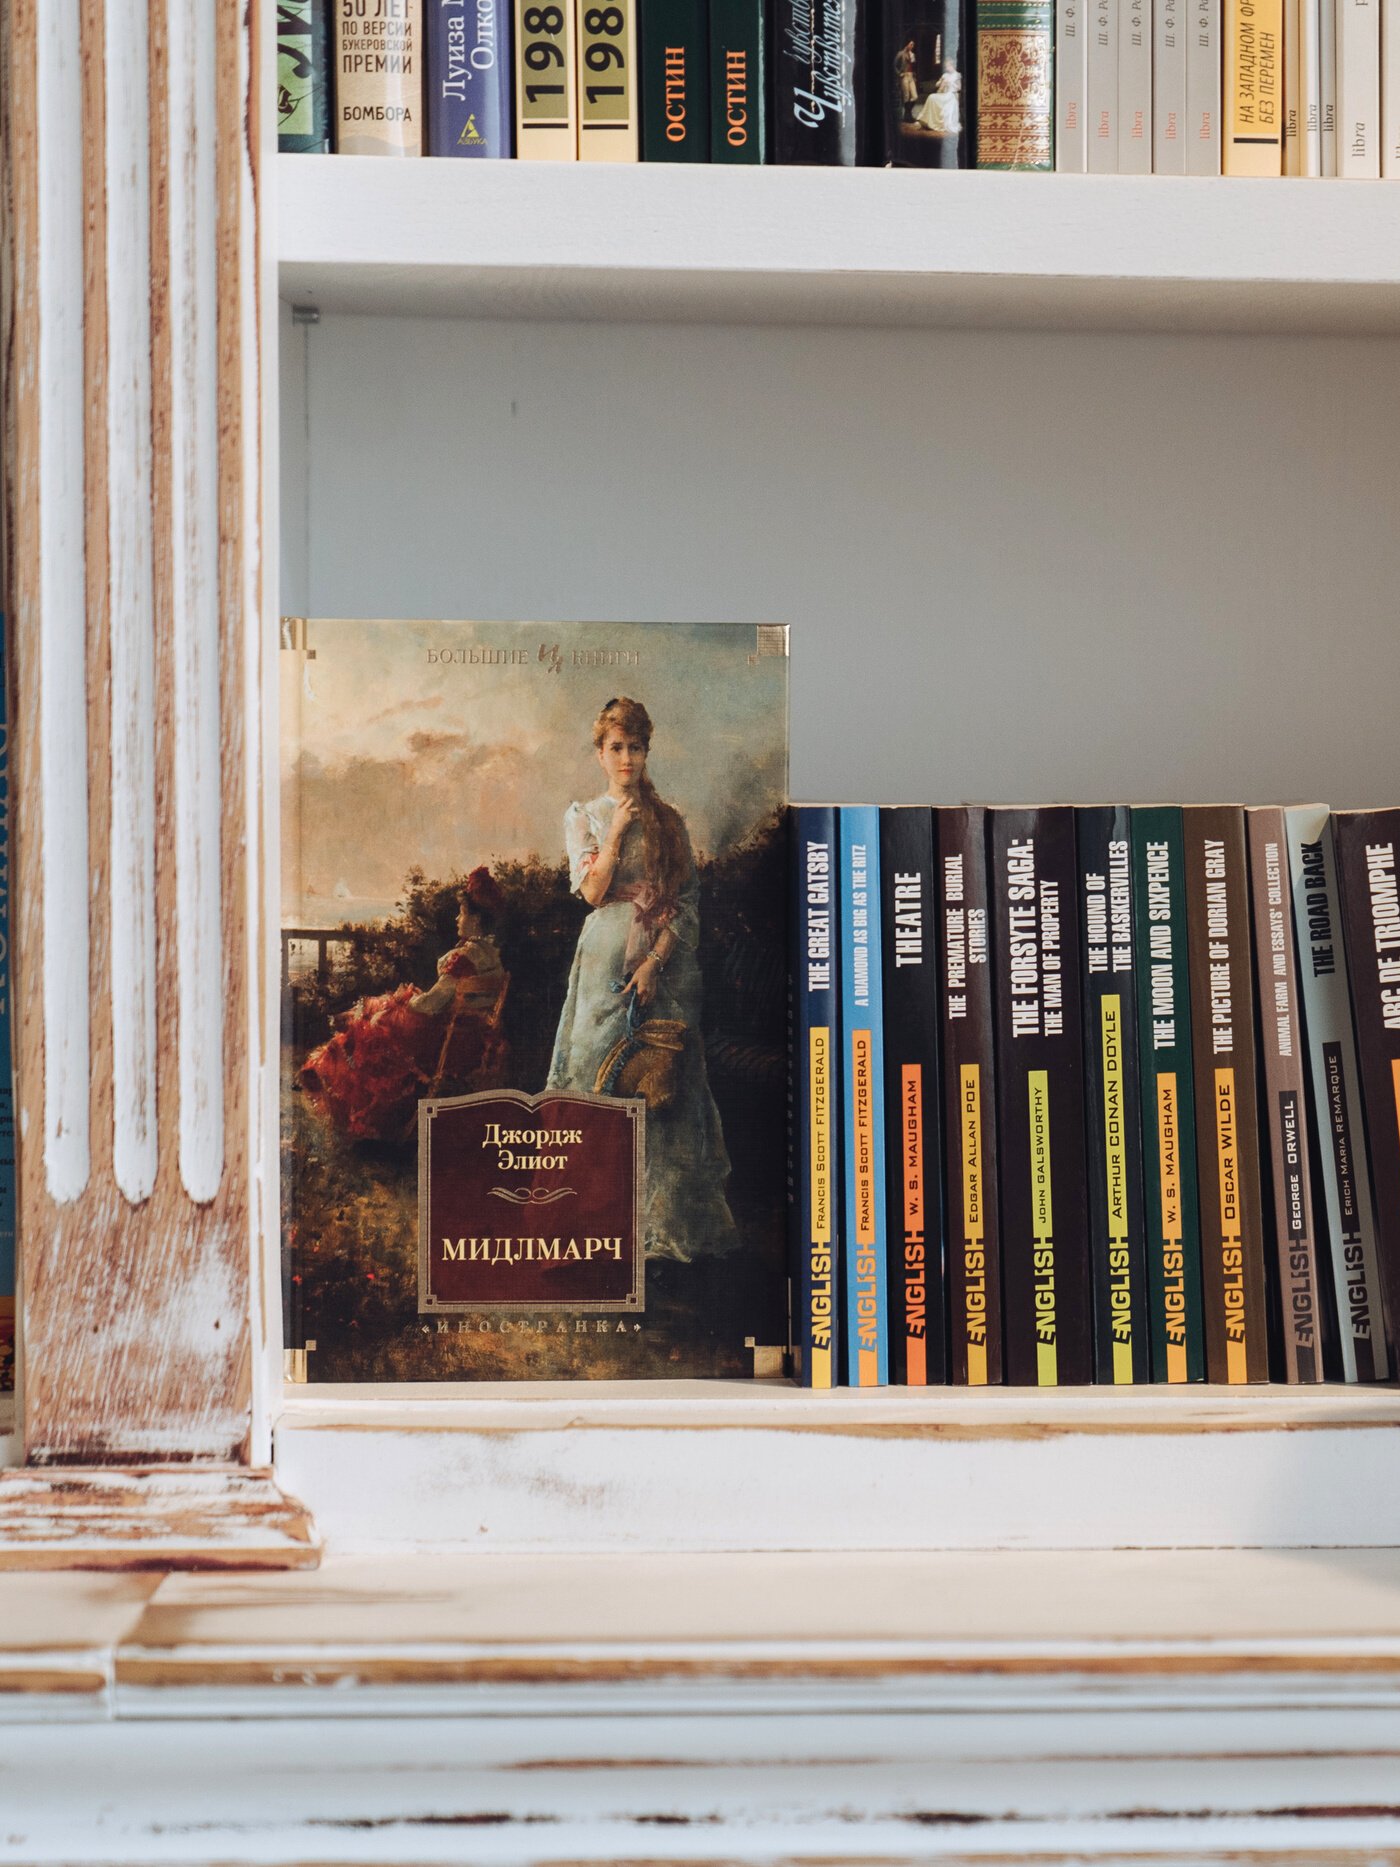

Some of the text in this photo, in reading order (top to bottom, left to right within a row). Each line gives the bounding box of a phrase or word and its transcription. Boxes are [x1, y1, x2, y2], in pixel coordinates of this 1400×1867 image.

[342, 22, 412, 36] ПО ВЕРСИИ
[342, 39, 412, 51] БУКЕРОВСКОЙ
[343, 55, 412, 74] ПРЕМИИ
[442, 16, 472, 101] Луиза
[1240, 22, 1257, 123] НА ЗАПАДНОМ
[344, 106, 412, 121] БОМБОРА
[665, 47, 686, 142] ОСТИН
[726, 51, 746, 146] ОСТИН
[1132, 112, 1142, 138] libra
[1259, 32, 1274, 124] БЕЗ ПЕРЕМЕН
[1324, 104, 1333, 131] libra
[427, 649, 528, 664] БОЛЬШИЕ
[572, 650, 640, 666] КНИГИ
[807, 841, 830, 992] THE GREAT GATSBY
[894, 872, 922, 967] THEATRE
[1109, 839, 1132, 972] THE BASKERVILLES
[1265, 842, 1282, 905] COLLECTION
[1300, 841, 1336, 978] THE ROAD BACK
[852, 844, 869, 1007] A DIAMOND AS BIG AS THE RITZ
[945, 853, 966, 1019] THE PREMATURE BURIAL
[968, 908, 986, 964] STORIES
[1007, 839, 1040, 1038] THE FORSYTE SAGA:
[1040, 880, 1063, 1036] THE MAN OF PROPERTY
[1086, 872, 1108, 973] THE HOUND OF
[1146, 841, 1176, 1050] THE MOON AND SIXPENCE
[1204, 839, 1234, 1054] THE PICTURE OF DORIAN GRAY
[1272, 953, 1286, 976] AND
[1275, 982, 1288, 1012] FARM
[1276, 1014, 1292, 1057] ANIMAL
[482, 1124, 582, 1148] Джордж
[498, 1150, 568, 1170] Элиот
[815, 1037, 825, 1228] FRANCIS SCOTT FITZGERALD
[908, 1080, 917, 1167] MAUGHAM
[965, 1079, 978, 1223] EDGAR ALLAN POE
[1035, 1087, 1046, 1224] JOHN GALSWORTHY
[1106, 1011, 1122, 1219] ARTHUR CONAN DOYLE
[1219, 1084, 1236, 1219] OSCAR WILDE
[1285, 1100, 1302, 1230] GEORGE ORWELL
[442, 1238, 623, 1265] МИДЛМАРЧ
[811, 1241, 831, 1350] ENGLISH
